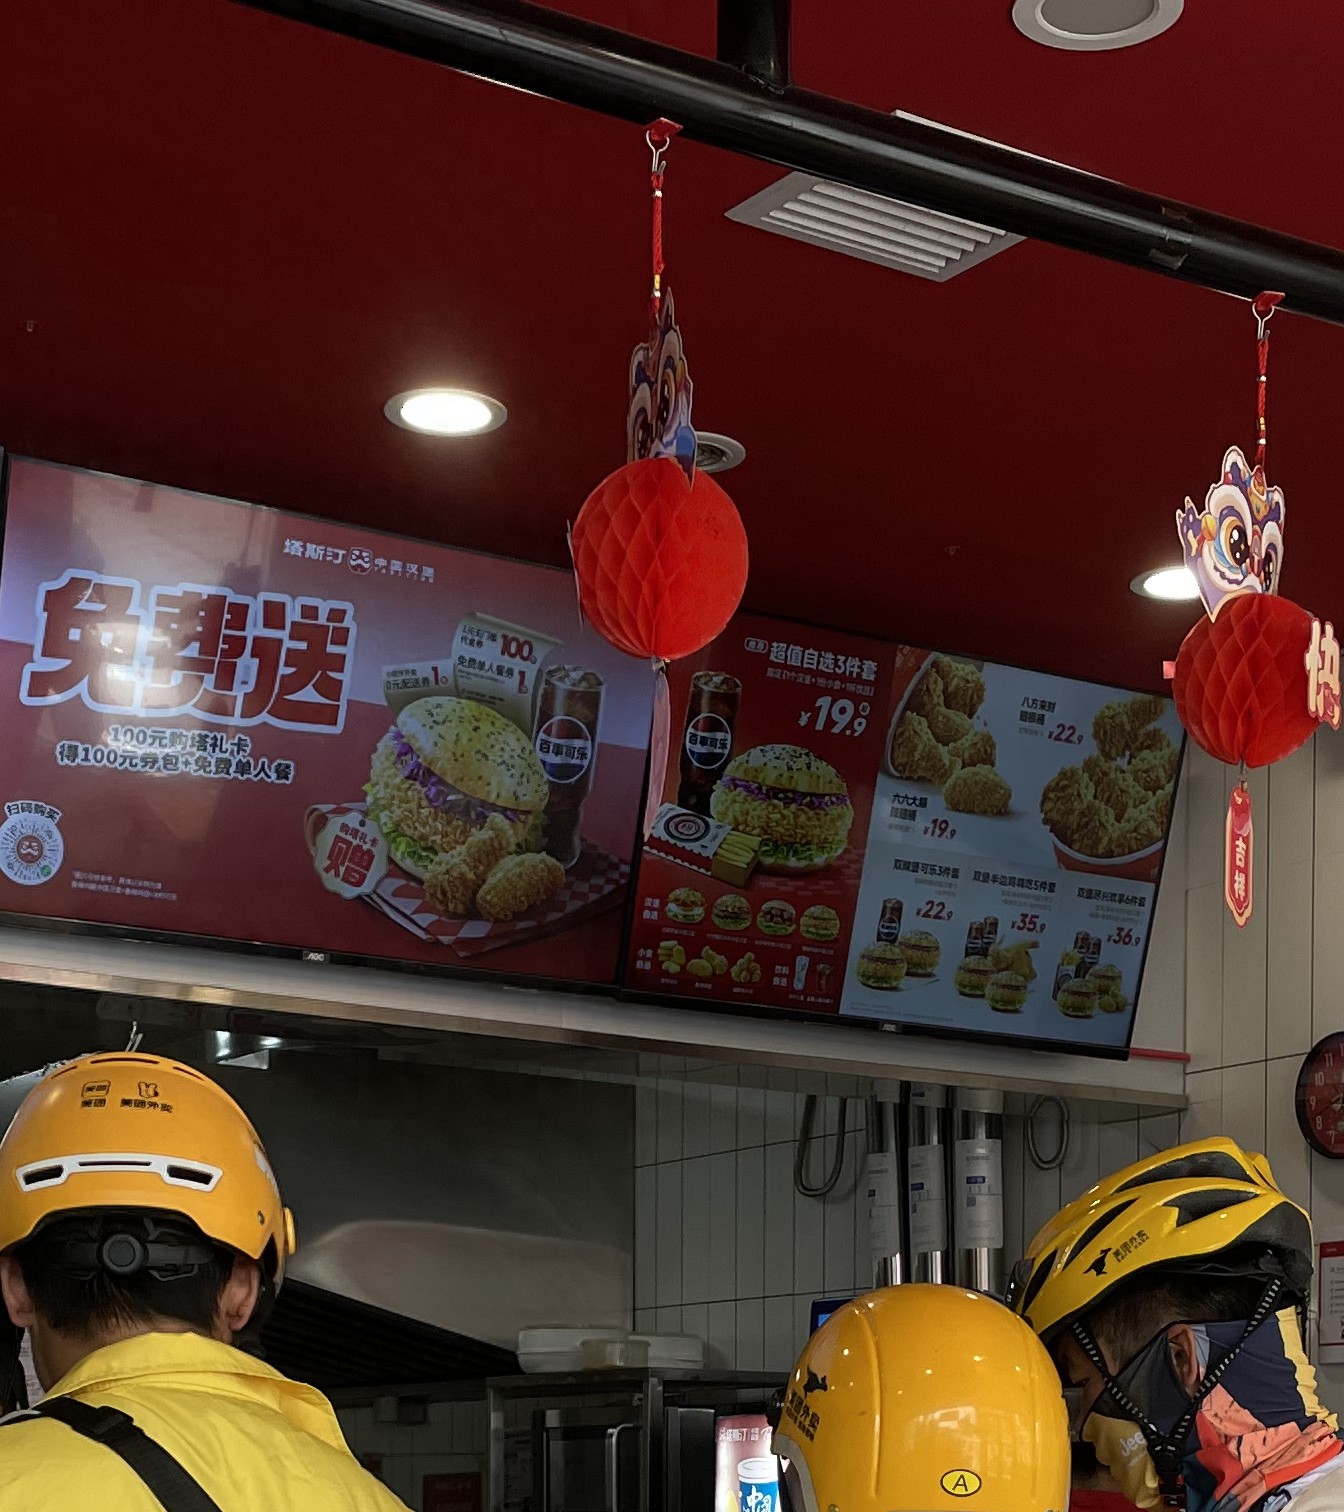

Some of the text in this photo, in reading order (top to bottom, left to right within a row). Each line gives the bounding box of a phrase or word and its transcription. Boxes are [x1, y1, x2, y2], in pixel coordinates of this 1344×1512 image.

[19, 569, 357, 734] 免费送
[768, 641, 878, 682] 超值自选3件套
[798, 695, 868, 737] ¥19.9
